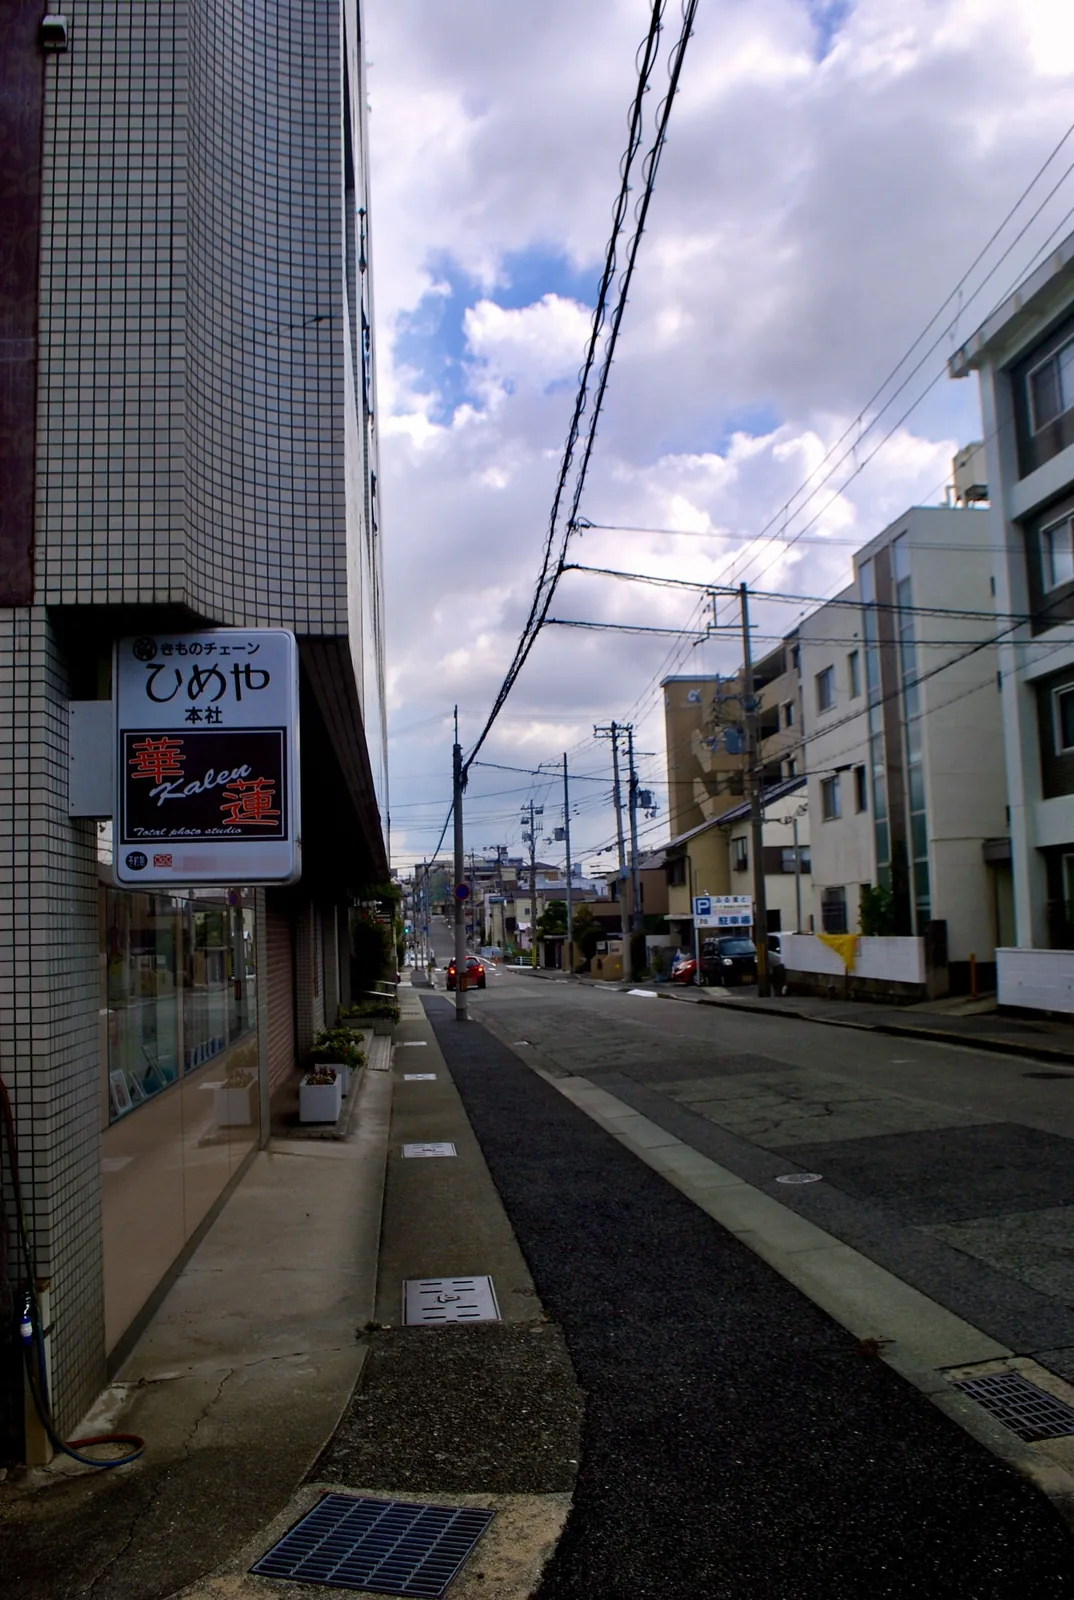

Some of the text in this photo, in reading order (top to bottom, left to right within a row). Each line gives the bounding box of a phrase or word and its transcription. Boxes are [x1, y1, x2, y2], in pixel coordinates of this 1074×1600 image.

[160, 642, 260, 656] きものチェーン
[145, 662, 270, 702] ひめや
[184, 706, 223, 724] 本社
[129, 737, 186, 784] 華
[149, 764, 252, 806] Kalen
[220, 777, 280, 826] 蓮
[133, 826, 243, 837] Total photo studio
[697, 899, 710, 914] P
